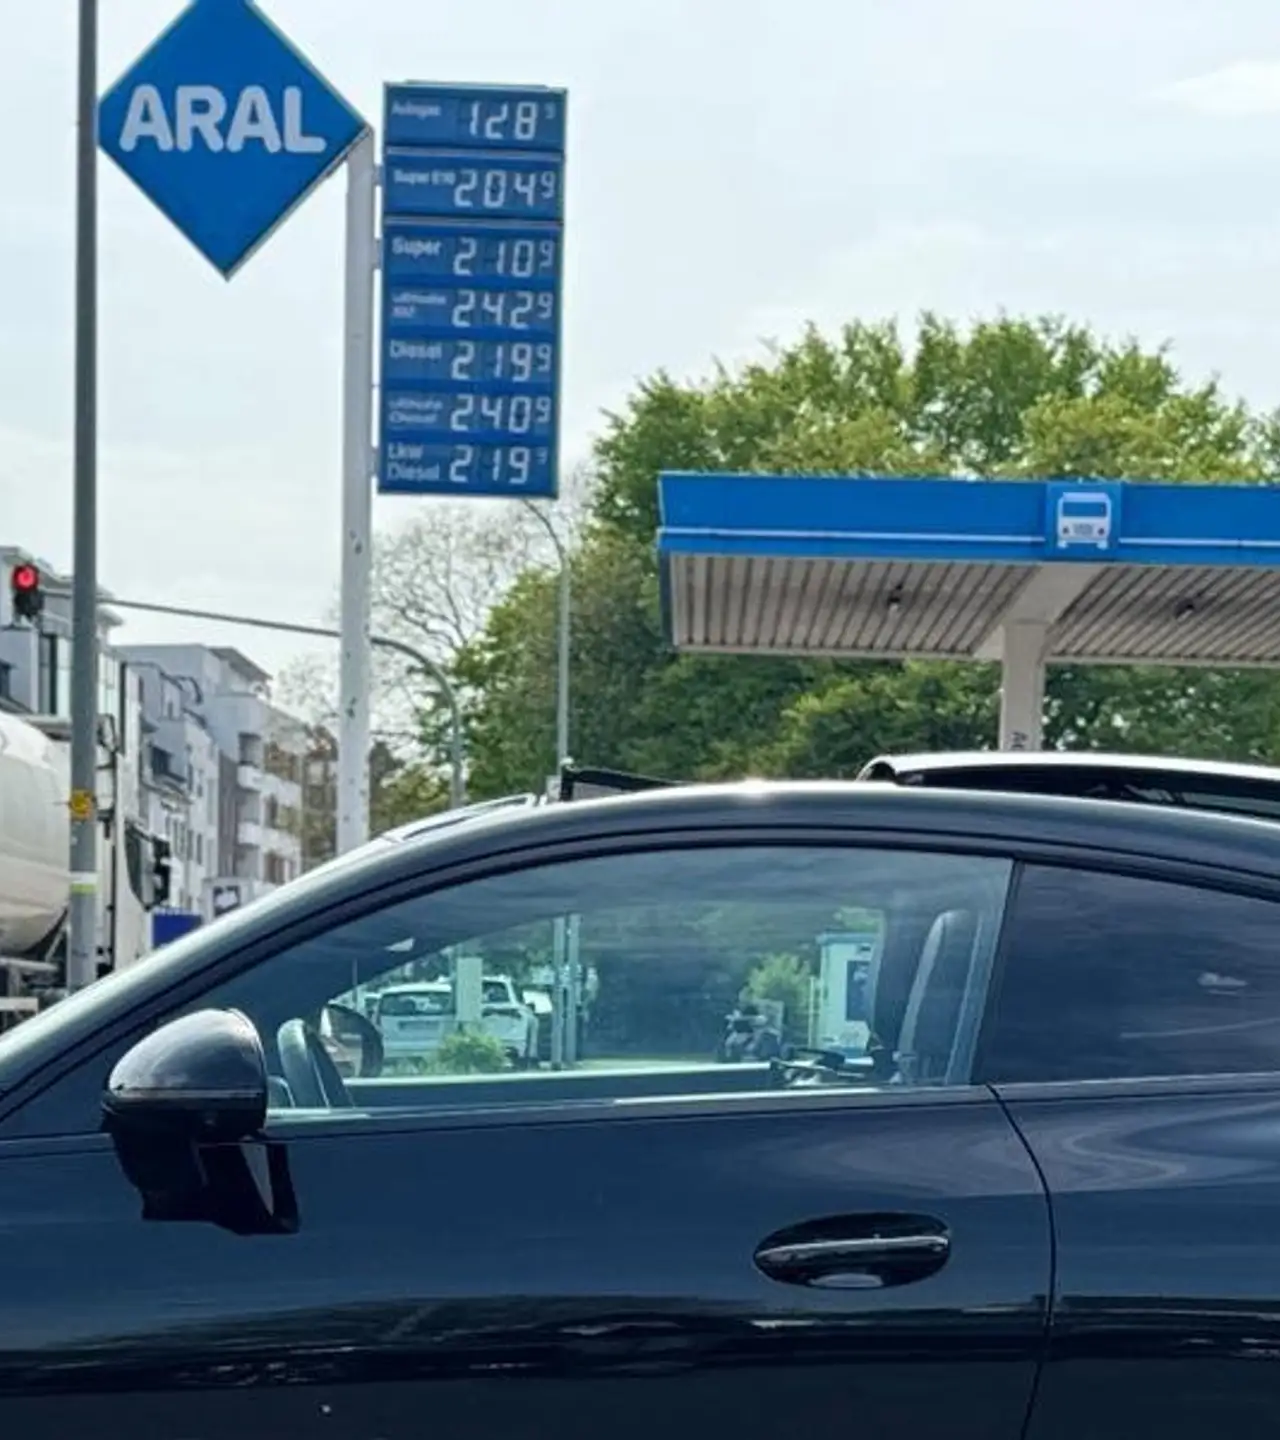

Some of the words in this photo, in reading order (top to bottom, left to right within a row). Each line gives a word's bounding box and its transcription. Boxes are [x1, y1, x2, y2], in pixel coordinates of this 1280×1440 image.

[119, 83, 328, 153] ARAL
[392, 236, 442, 259] Super
[389, 339, 442, 359] Diesel
[387, 461, 440, 481] Diesel
